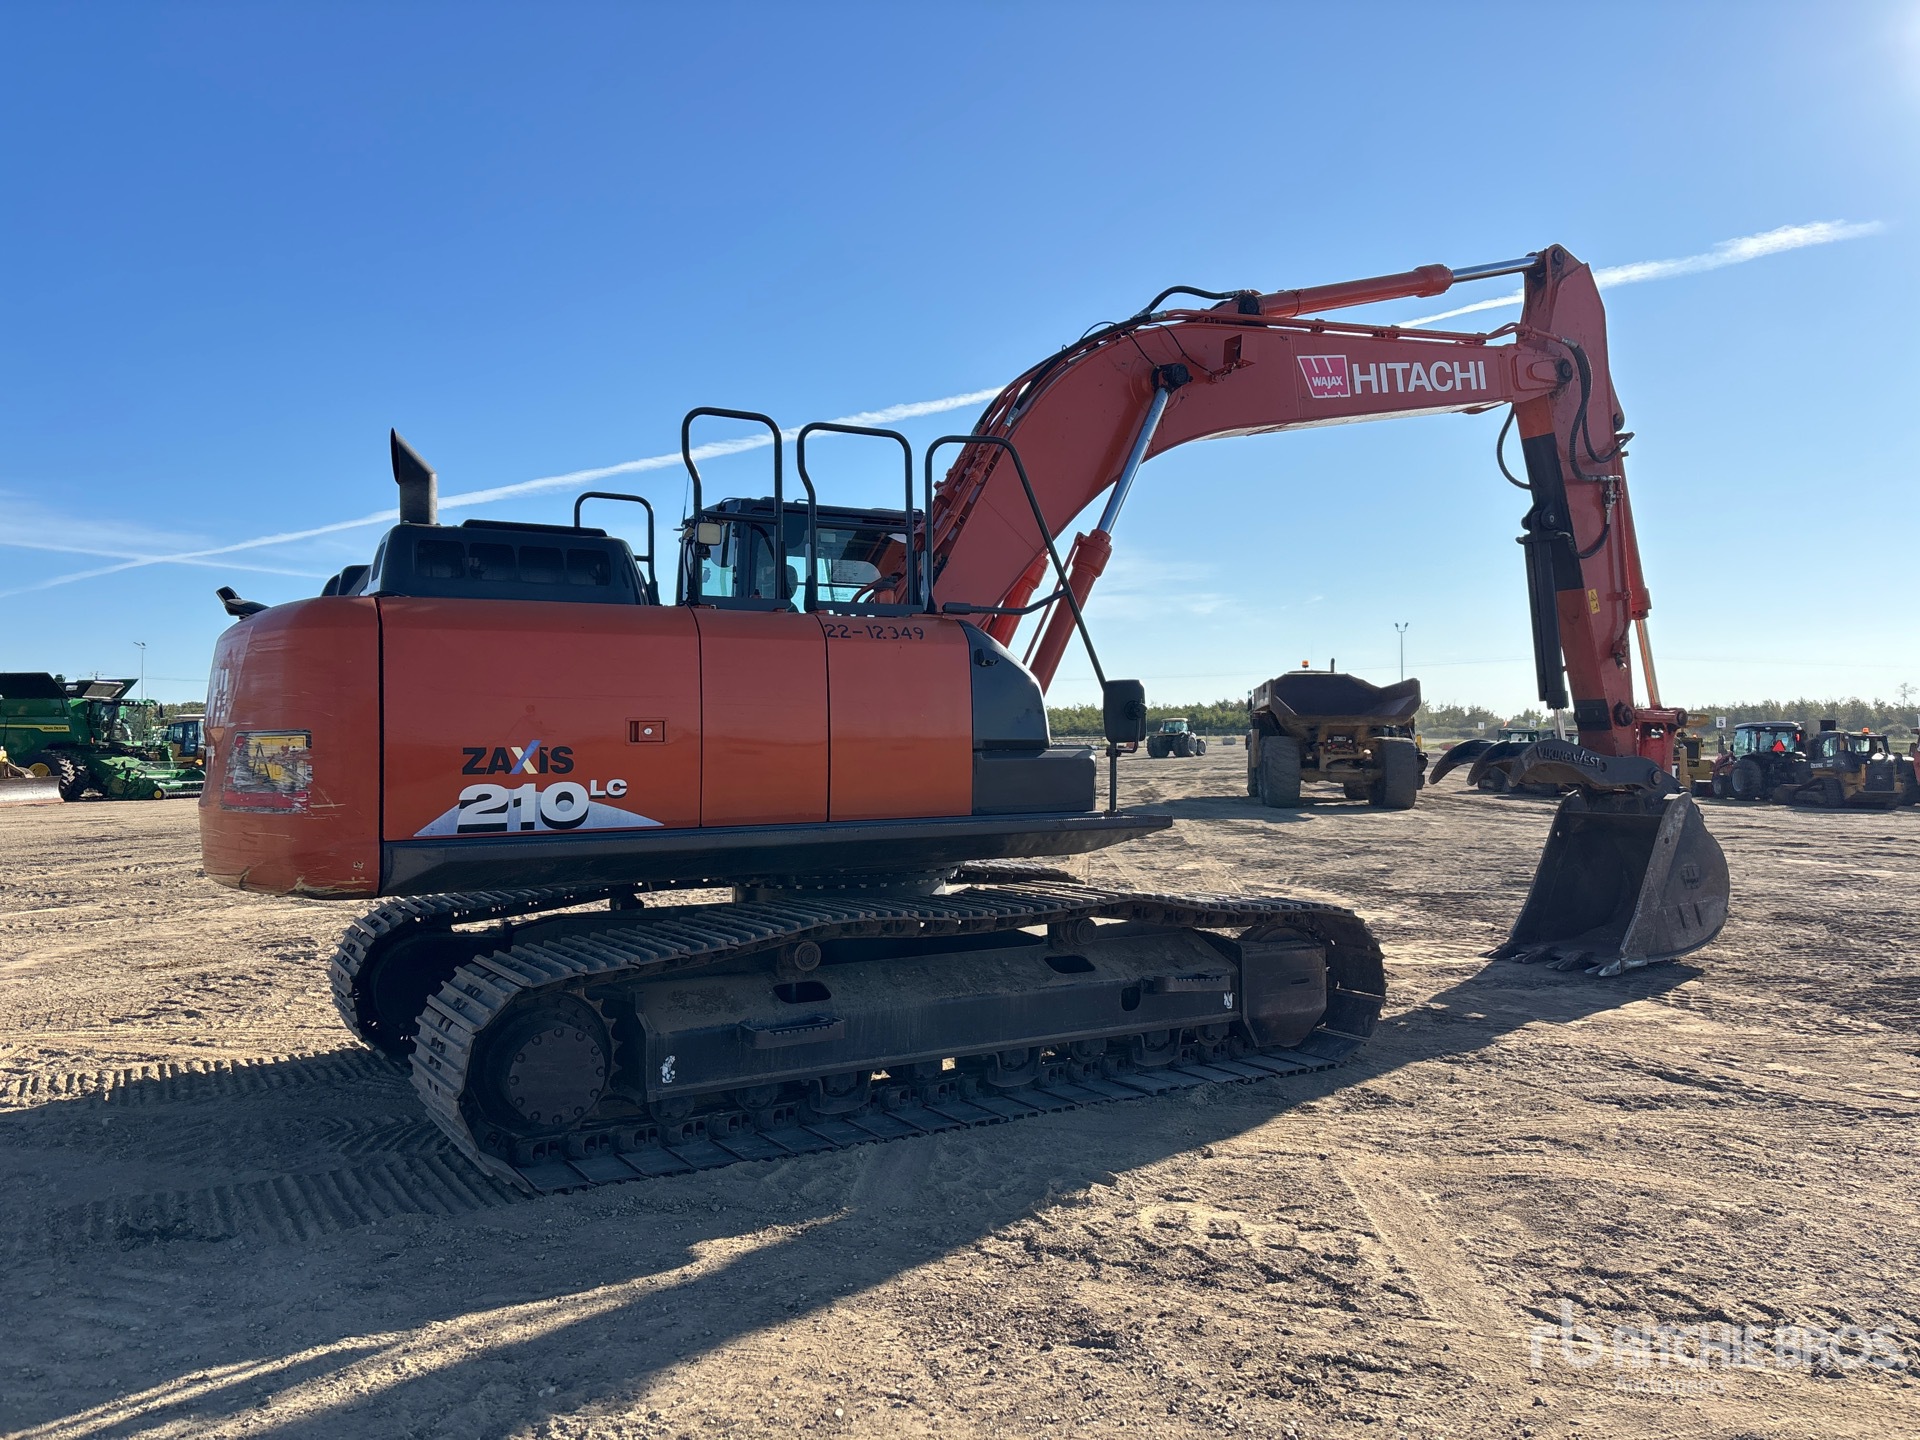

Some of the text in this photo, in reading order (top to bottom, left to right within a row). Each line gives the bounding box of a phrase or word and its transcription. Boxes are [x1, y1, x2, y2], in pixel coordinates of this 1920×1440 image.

[1311, 375, 1344, 389] WAJAX
[1352, 360, 1487, 394] HITACHI
[462, 739, 575, 775] ZAXIS
